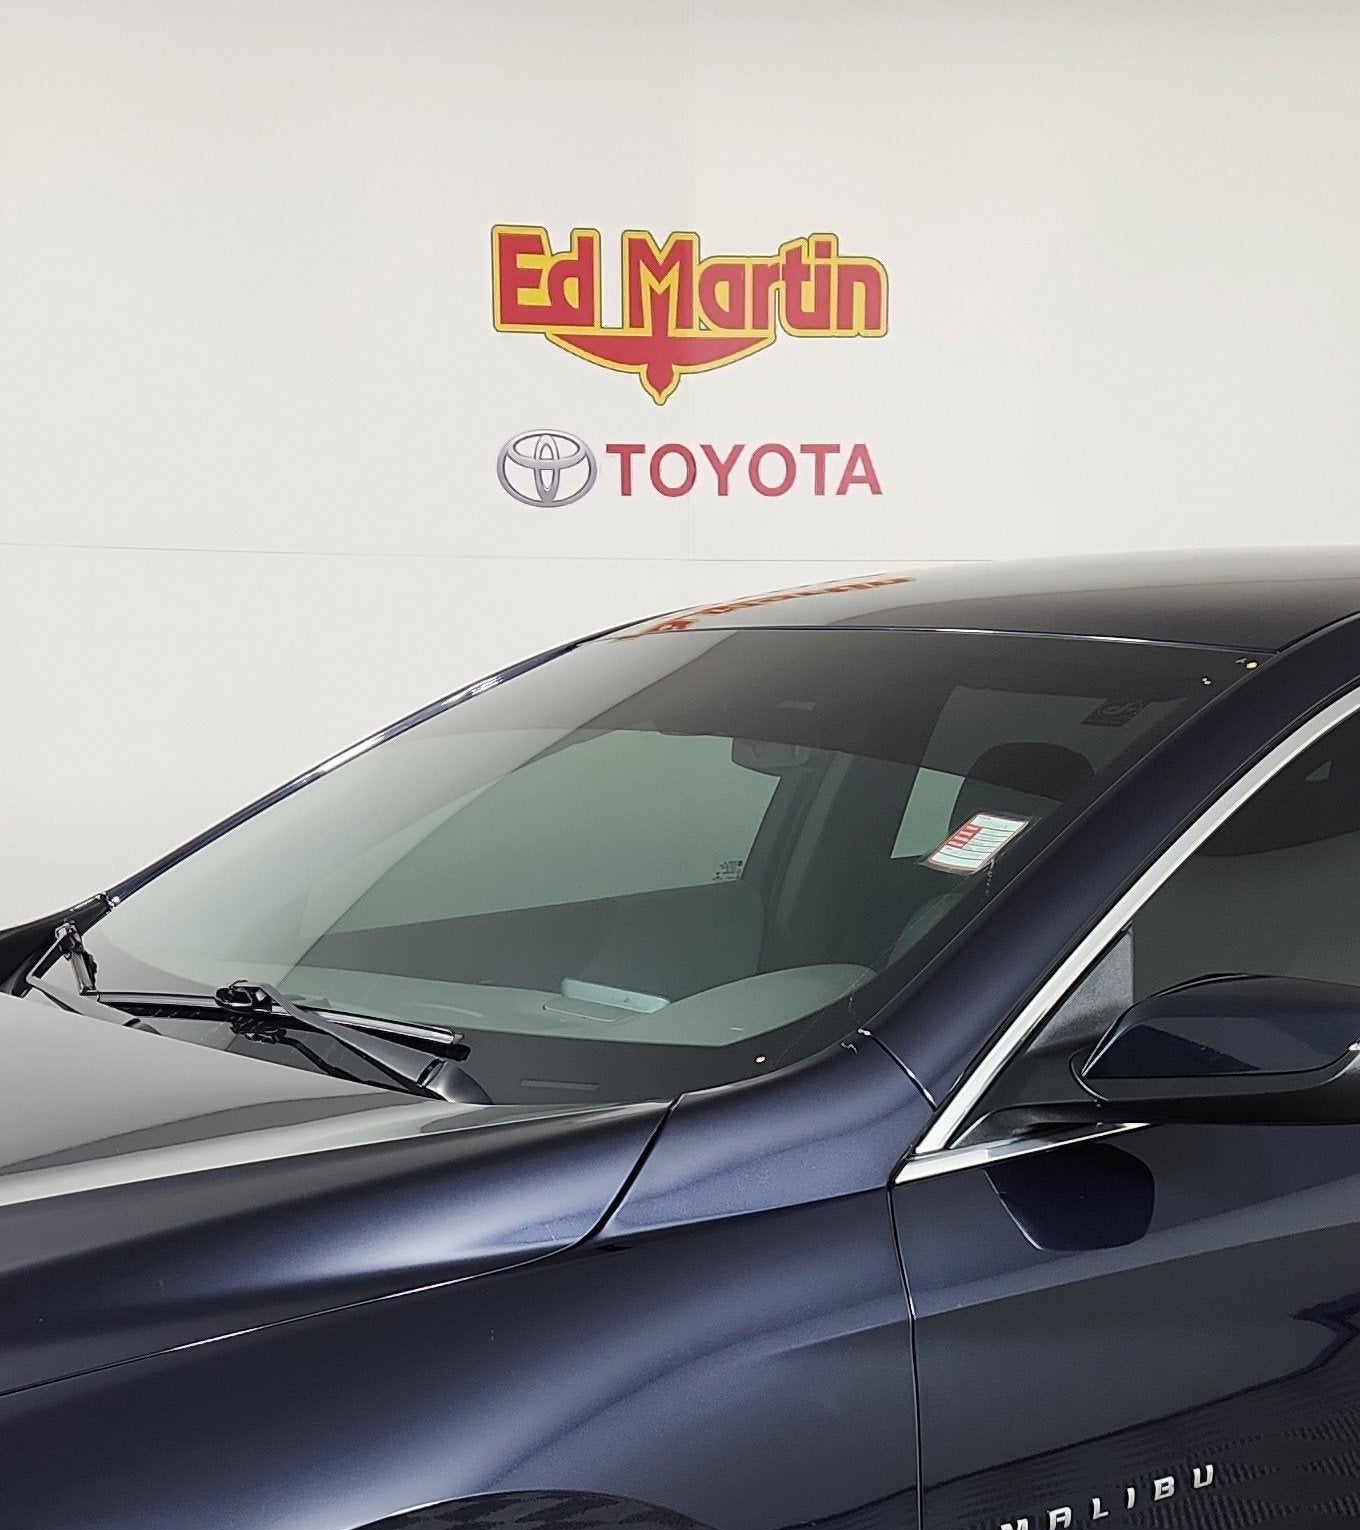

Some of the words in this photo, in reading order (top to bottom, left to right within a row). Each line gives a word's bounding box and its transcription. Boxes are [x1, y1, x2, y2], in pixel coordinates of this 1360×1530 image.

[493, 226, 600, 332] Ed
[622, 231, 888, 337] Martin
[605, 443, 883, 497] TOYOTA
